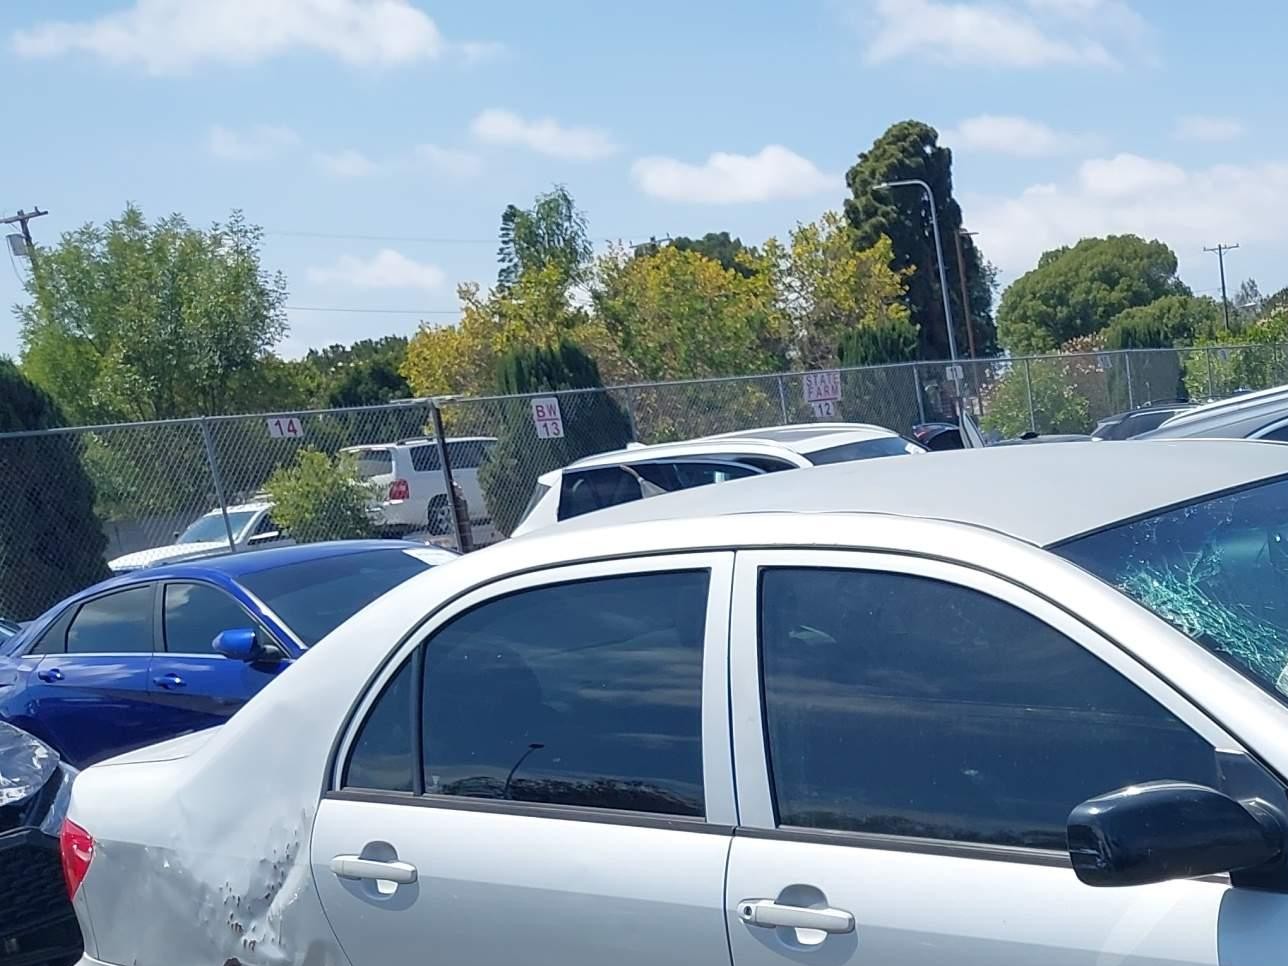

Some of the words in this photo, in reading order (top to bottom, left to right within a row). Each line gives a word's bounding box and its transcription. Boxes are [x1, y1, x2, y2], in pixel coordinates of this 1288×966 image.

[806, 374, 840, 387] STATE
[808, 385, 839, 399] FARM
[535, 403, 557, 418] BW
[817, 402, 832, 416] 12
[274, 419, 298, 436] 14
[542, 421, 561, 437] 13
